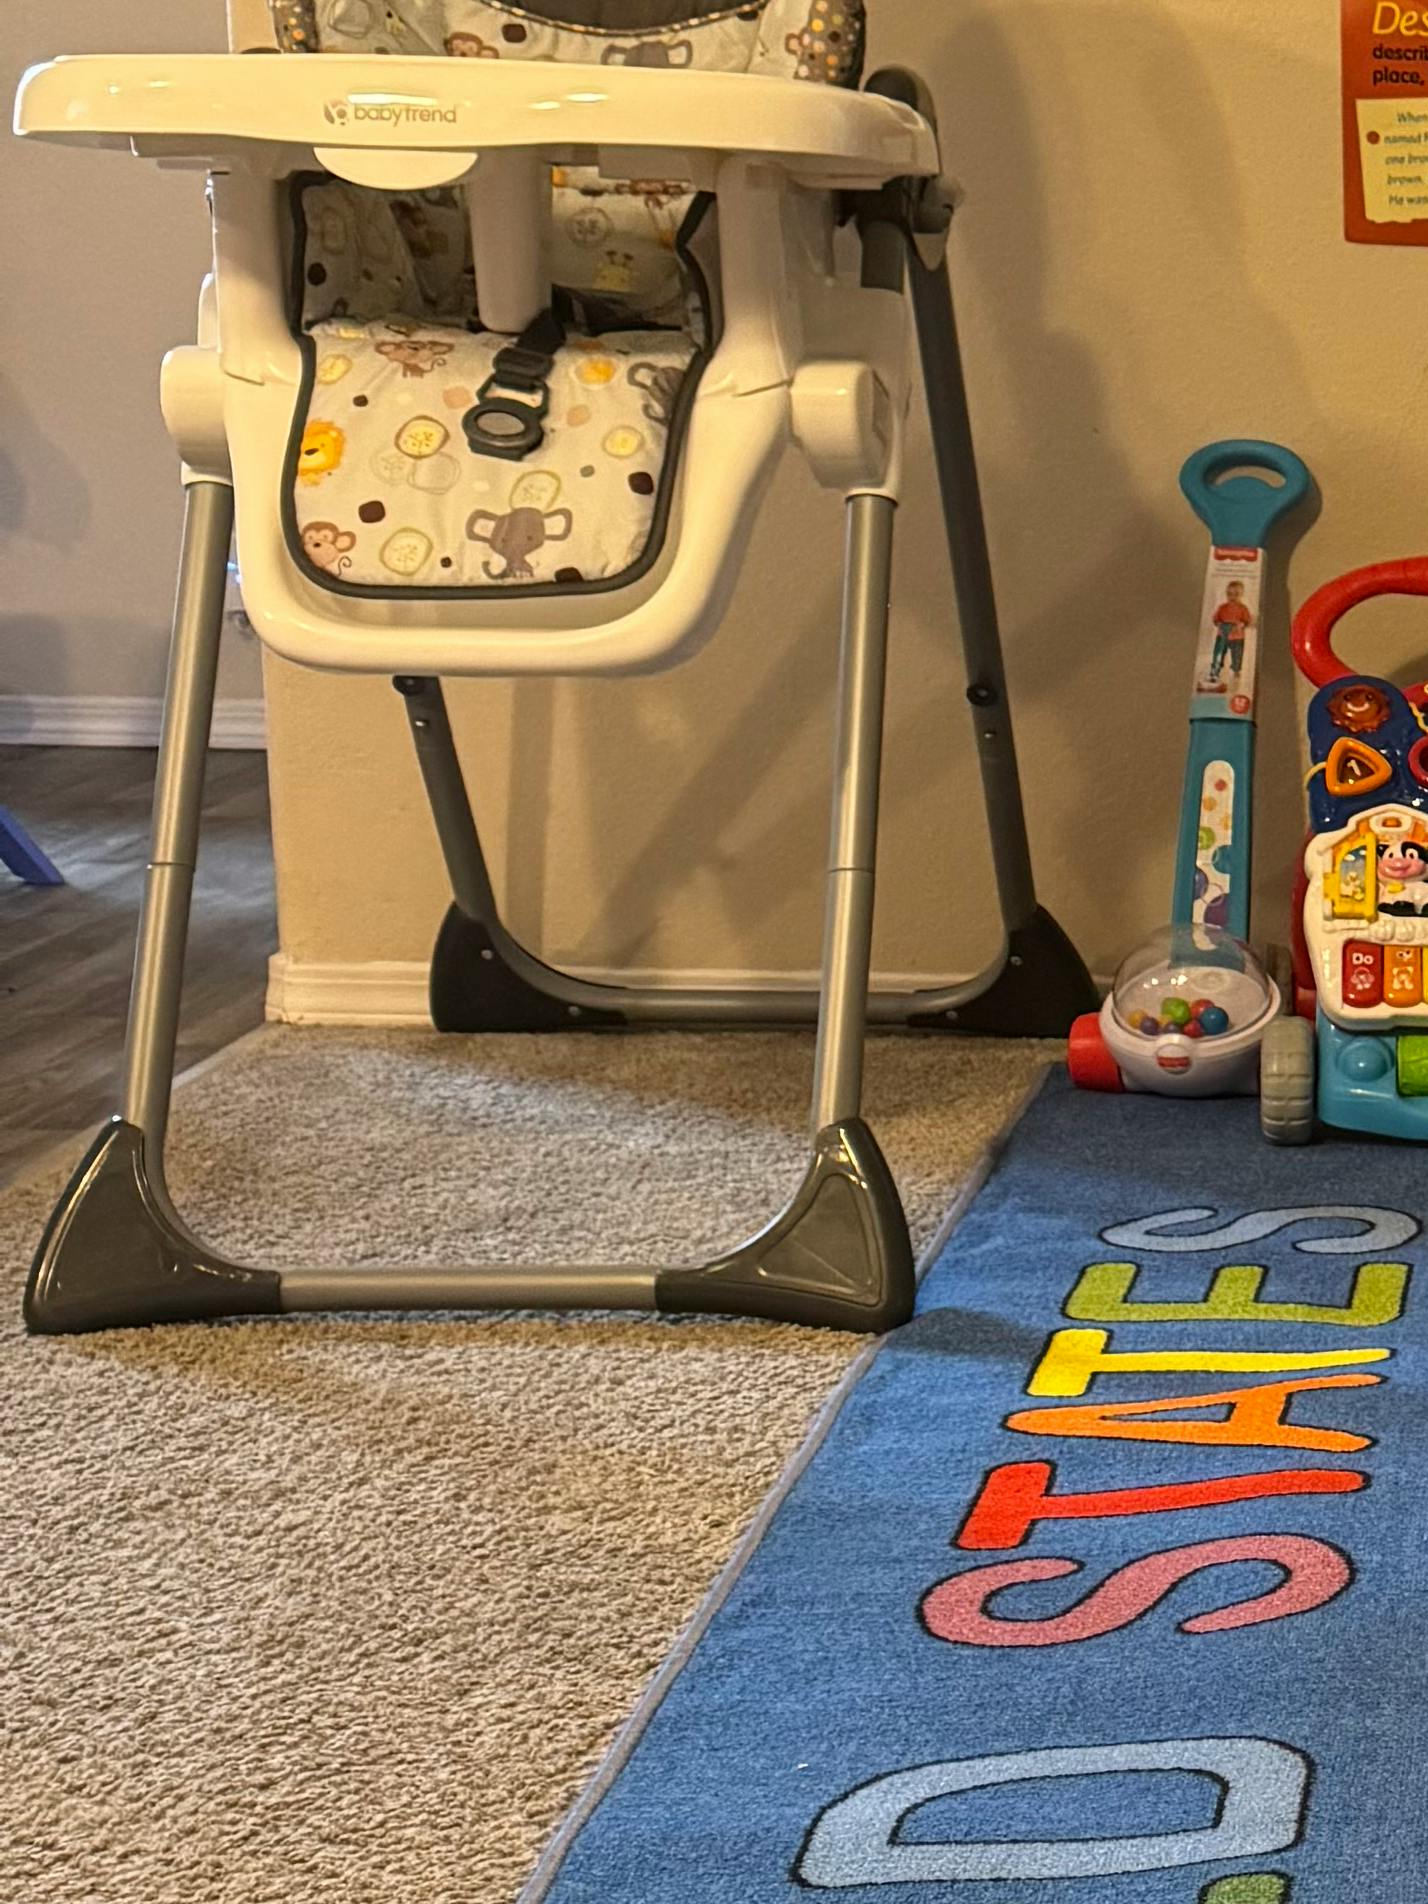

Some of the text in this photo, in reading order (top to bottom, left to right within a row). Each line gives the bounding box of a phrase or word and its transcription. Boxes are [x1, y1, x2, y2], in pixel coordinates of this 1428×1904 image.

[1372, 68, 1424, 86] place,
[1346, 758, 1362, 777] 1
[1352, 952, 1374, 965] Do
[916, 1201, 1422, 1649] STATES
